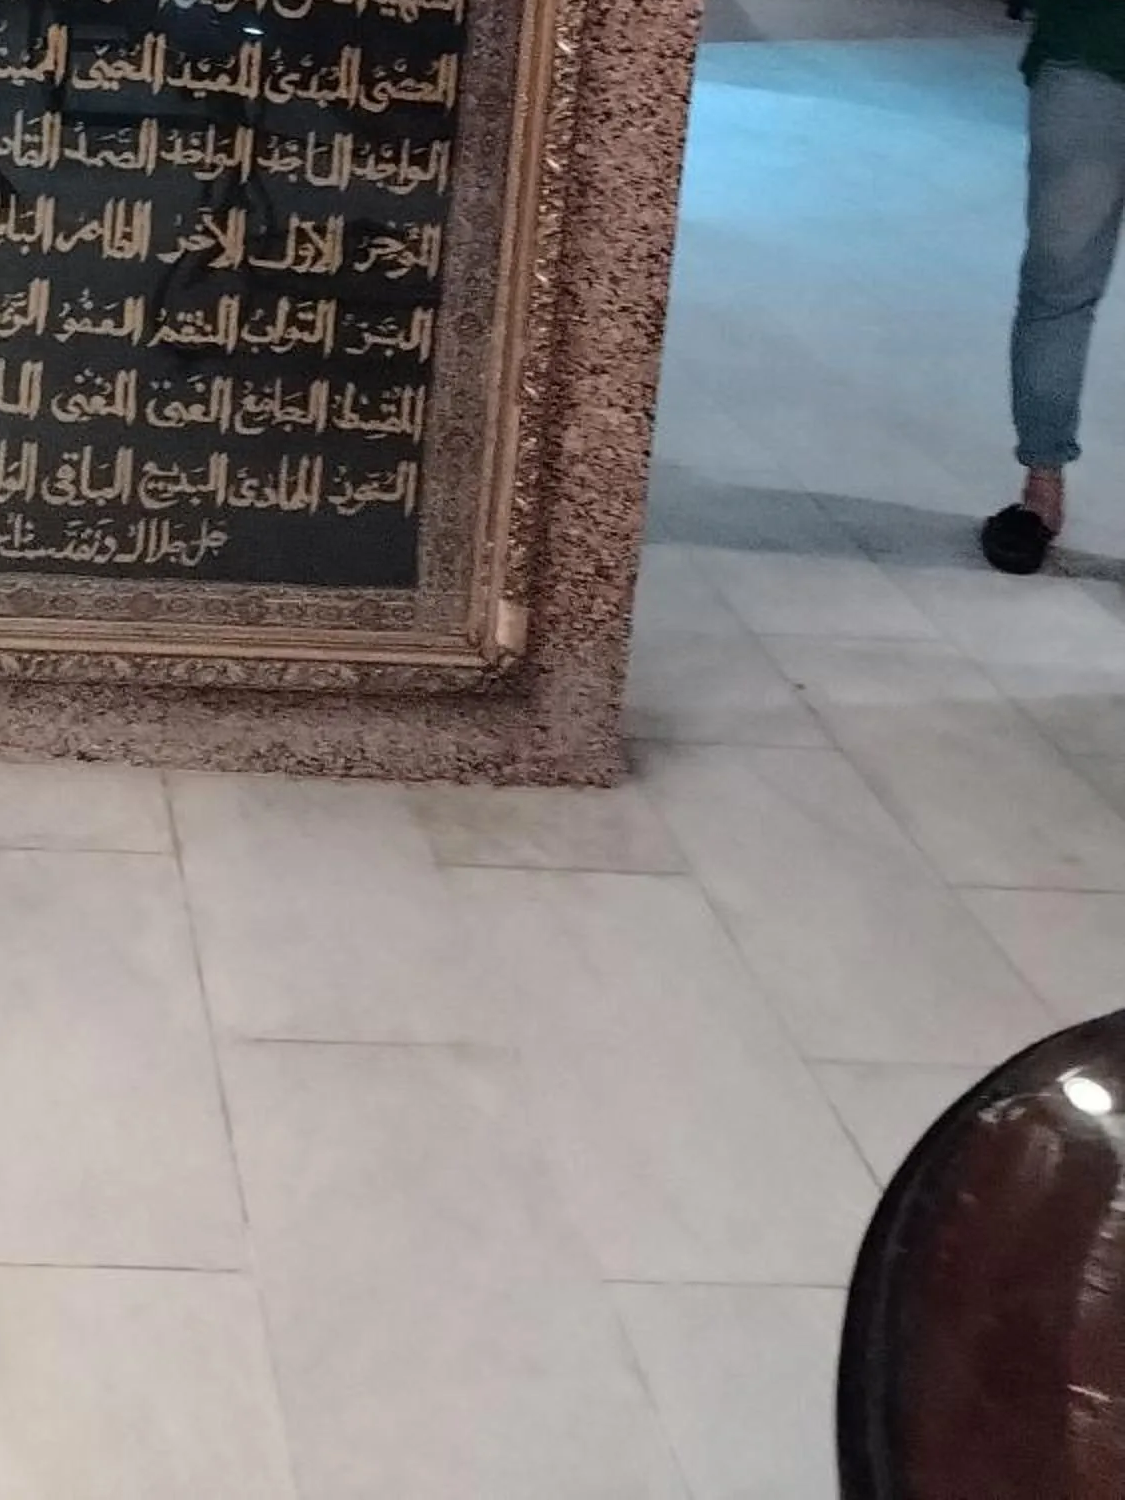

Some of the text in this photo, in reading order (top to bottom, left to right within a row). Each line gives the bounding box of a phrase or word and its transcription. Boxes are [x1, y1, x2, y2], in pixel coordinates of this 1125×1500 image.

[62, 115, 158, 175] الصمد
[159, 122, 254, 182] الواحد
[55, 291, 146, 345] العفو
[241, 296, 337, 357] التواب
[343, 303, 434, 362] البر
[234, 376, 330, 438] الجامع
[137, 448, 228, 512] البديع
[327, 459, 417, 518] النور
